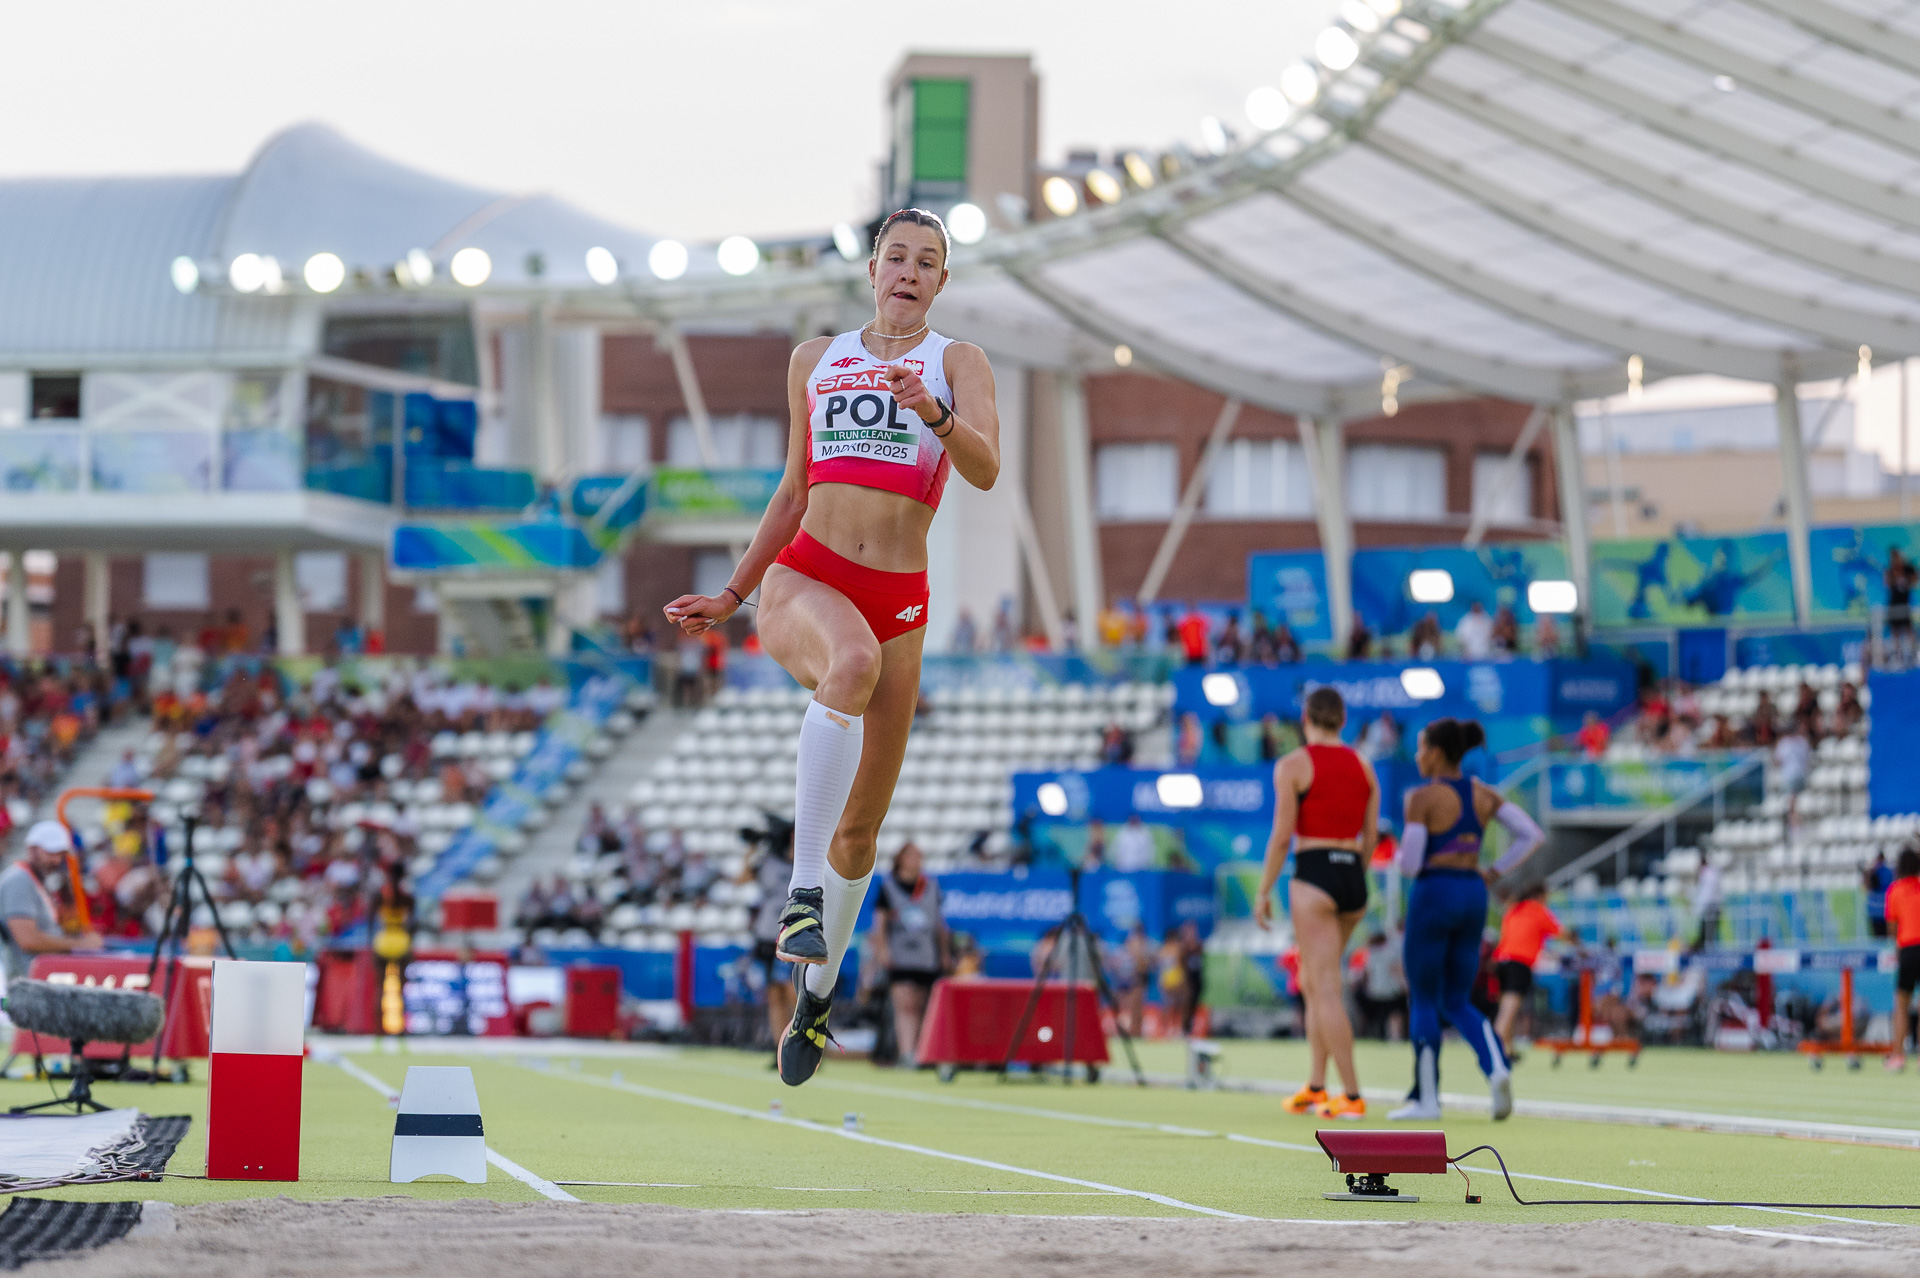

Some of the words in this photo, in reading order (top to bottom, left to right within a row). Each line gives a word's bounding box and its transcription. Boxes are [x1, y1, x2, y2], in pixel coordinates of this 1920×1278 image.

[830, 357, 865, 368] 4F
[818, 373, 891, 391] SPAR
[825, 393, 908, 431] POL
[833, 431, 837, 440] I
[838, 431, 859, 440] RUN
[873, 444, 908, 459] 2025
[895, 604, 923, 622] 4F
